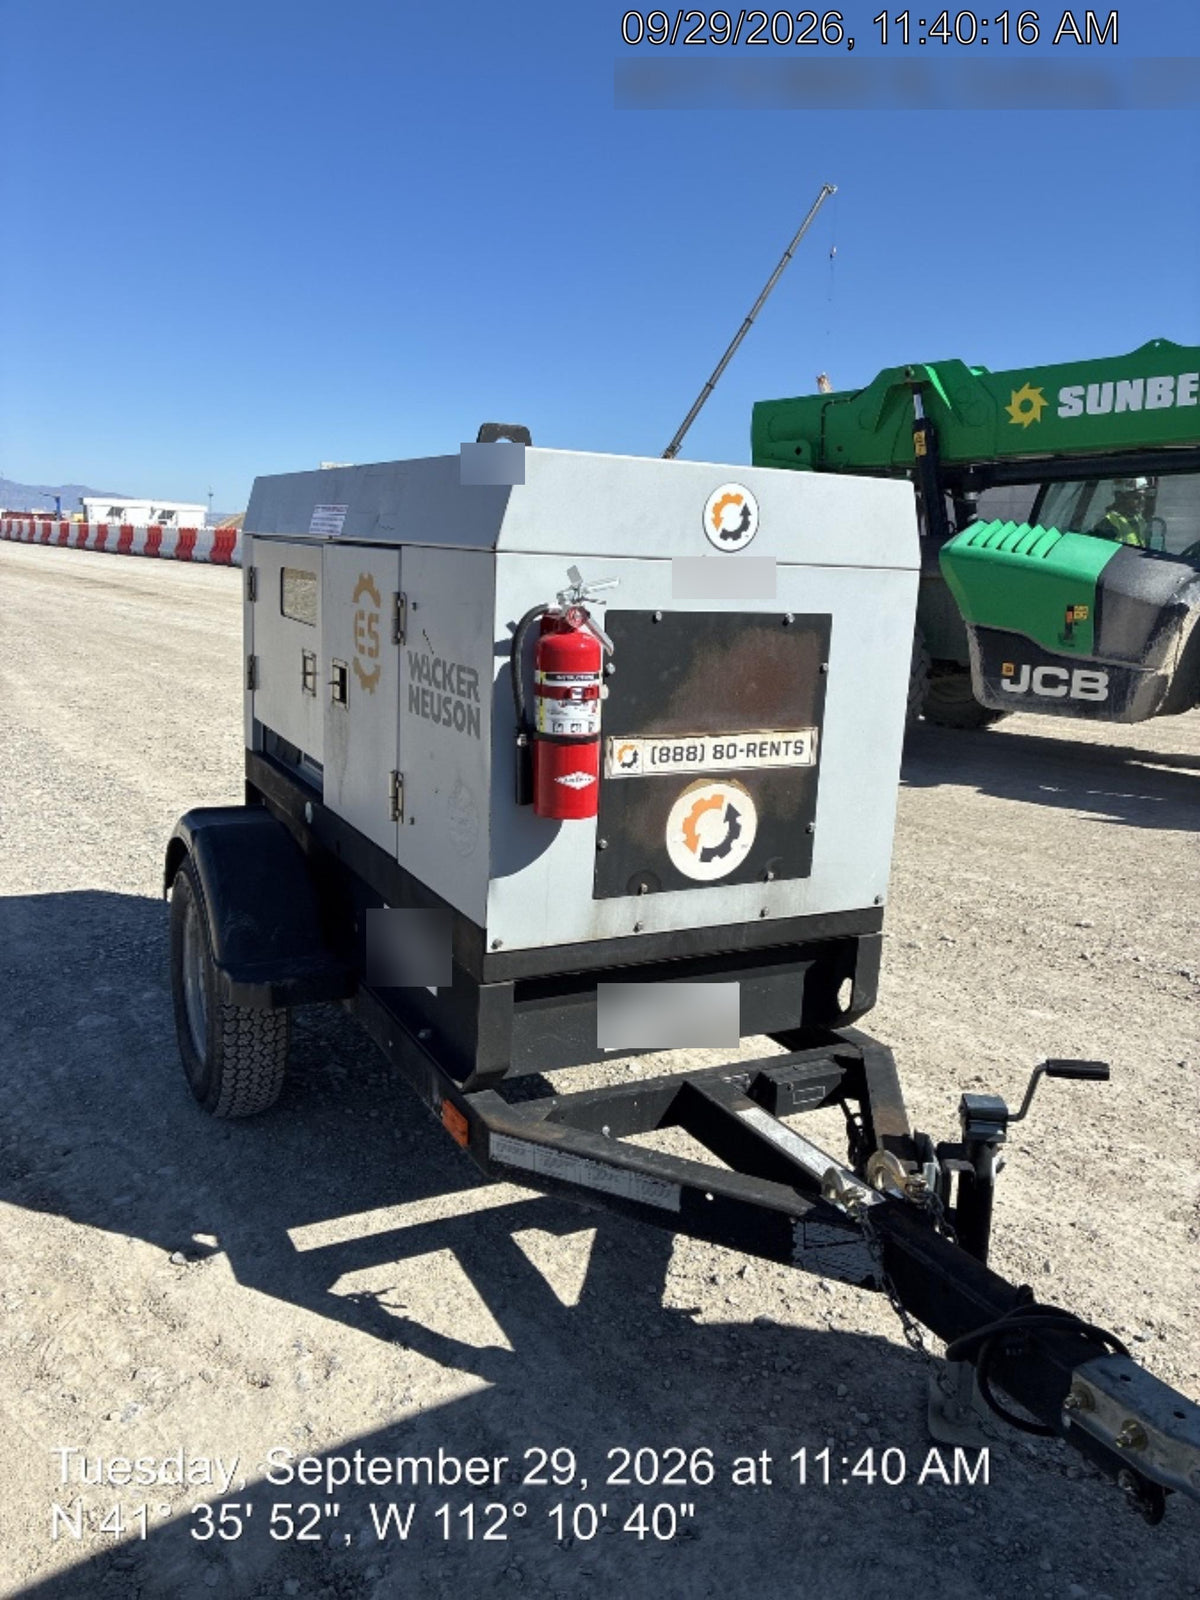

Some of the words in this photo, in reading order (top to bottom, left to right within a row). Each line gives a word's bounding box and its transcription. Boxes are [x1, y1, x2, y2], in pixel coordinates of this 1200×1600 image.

[1058, 373, 1200, 418] SUNBE
[407, 650, 481, 703] WACKER
[1001, 664, 1109, 701] JCB
[408, 684, 481, 741] NEUSON
[651, 743, 705, 765] (888)
[712, 740, 805, 760] 80-RENTS
